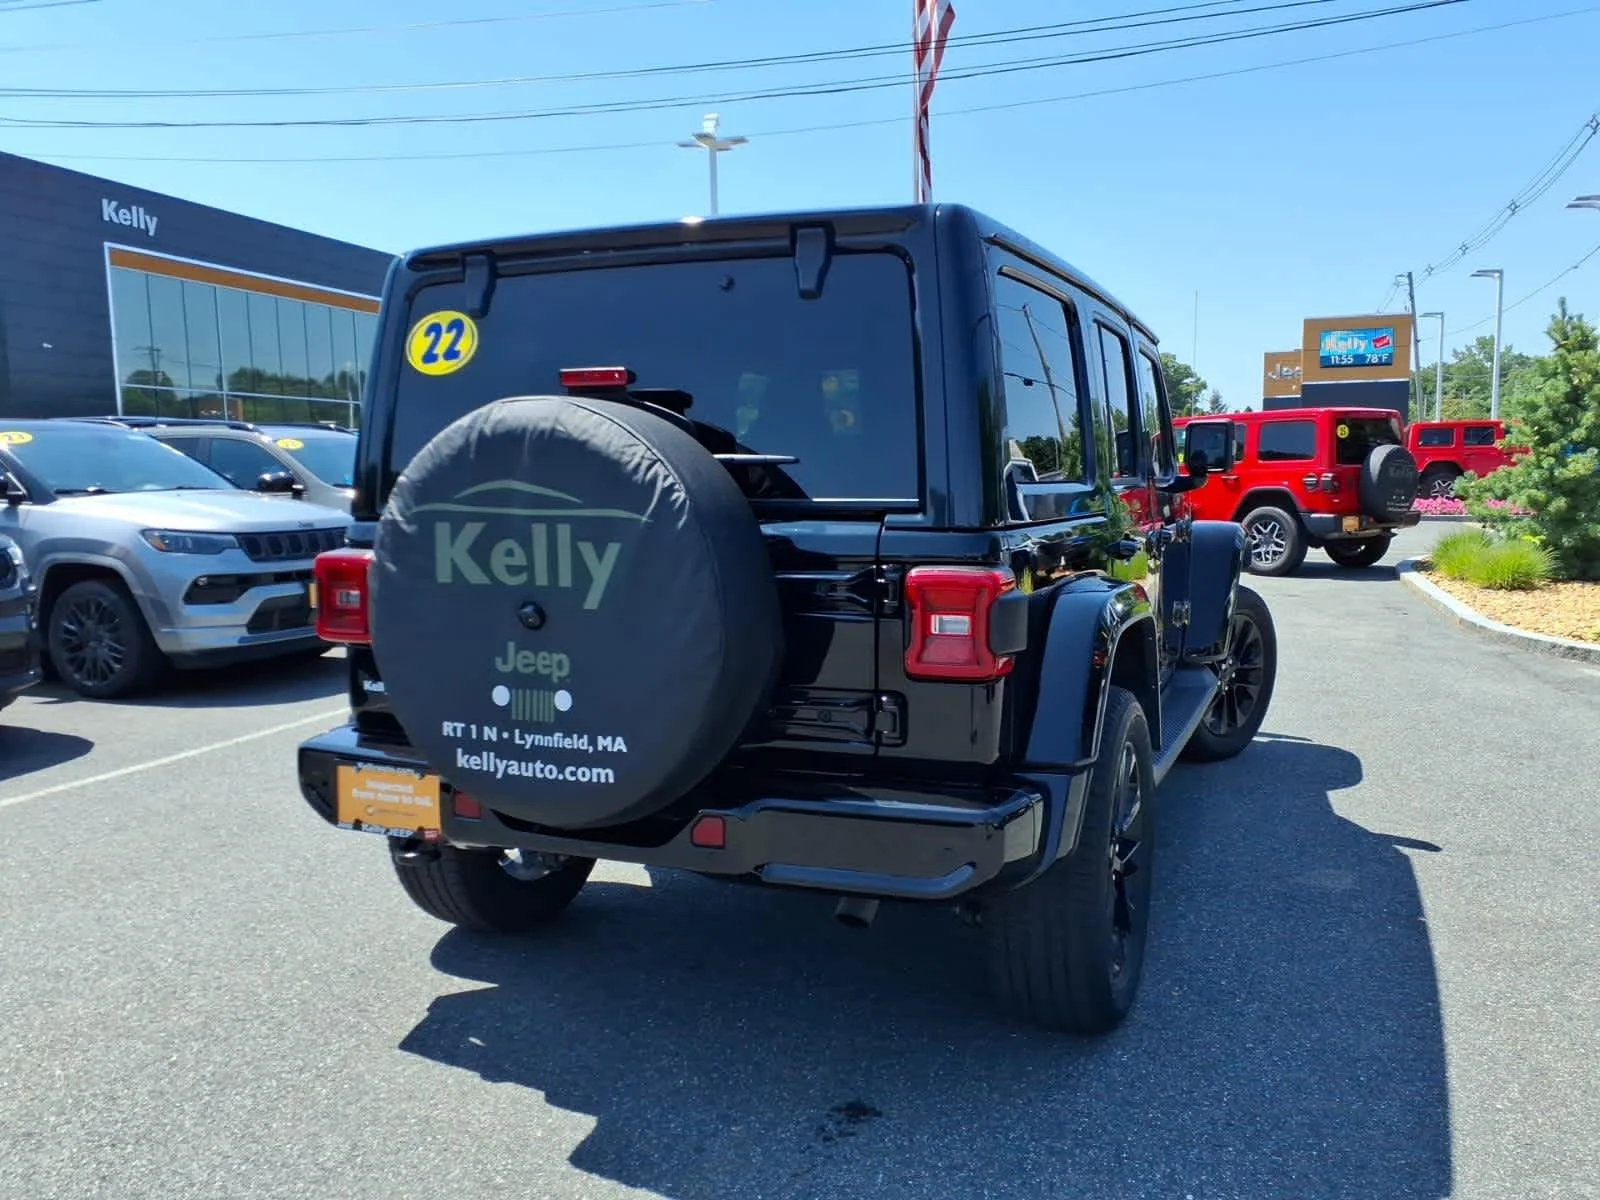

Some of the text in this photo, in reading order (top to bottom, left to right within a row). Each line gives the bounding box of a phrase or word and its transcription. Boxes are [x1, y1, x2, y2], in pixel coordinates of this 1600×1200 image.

[102, 198, 158, 237] Kelly
[421, 318, 465, 364] 22
[1267, 362, 1303, 380] Jee
[434, 521, 622, 610] Kelly
[495, 641, 570, 683] Jeep
[442, 721, 627, 754] RT 1 N Lynnfield, MA
[456, 748, 615, 784] kellyauto.com
